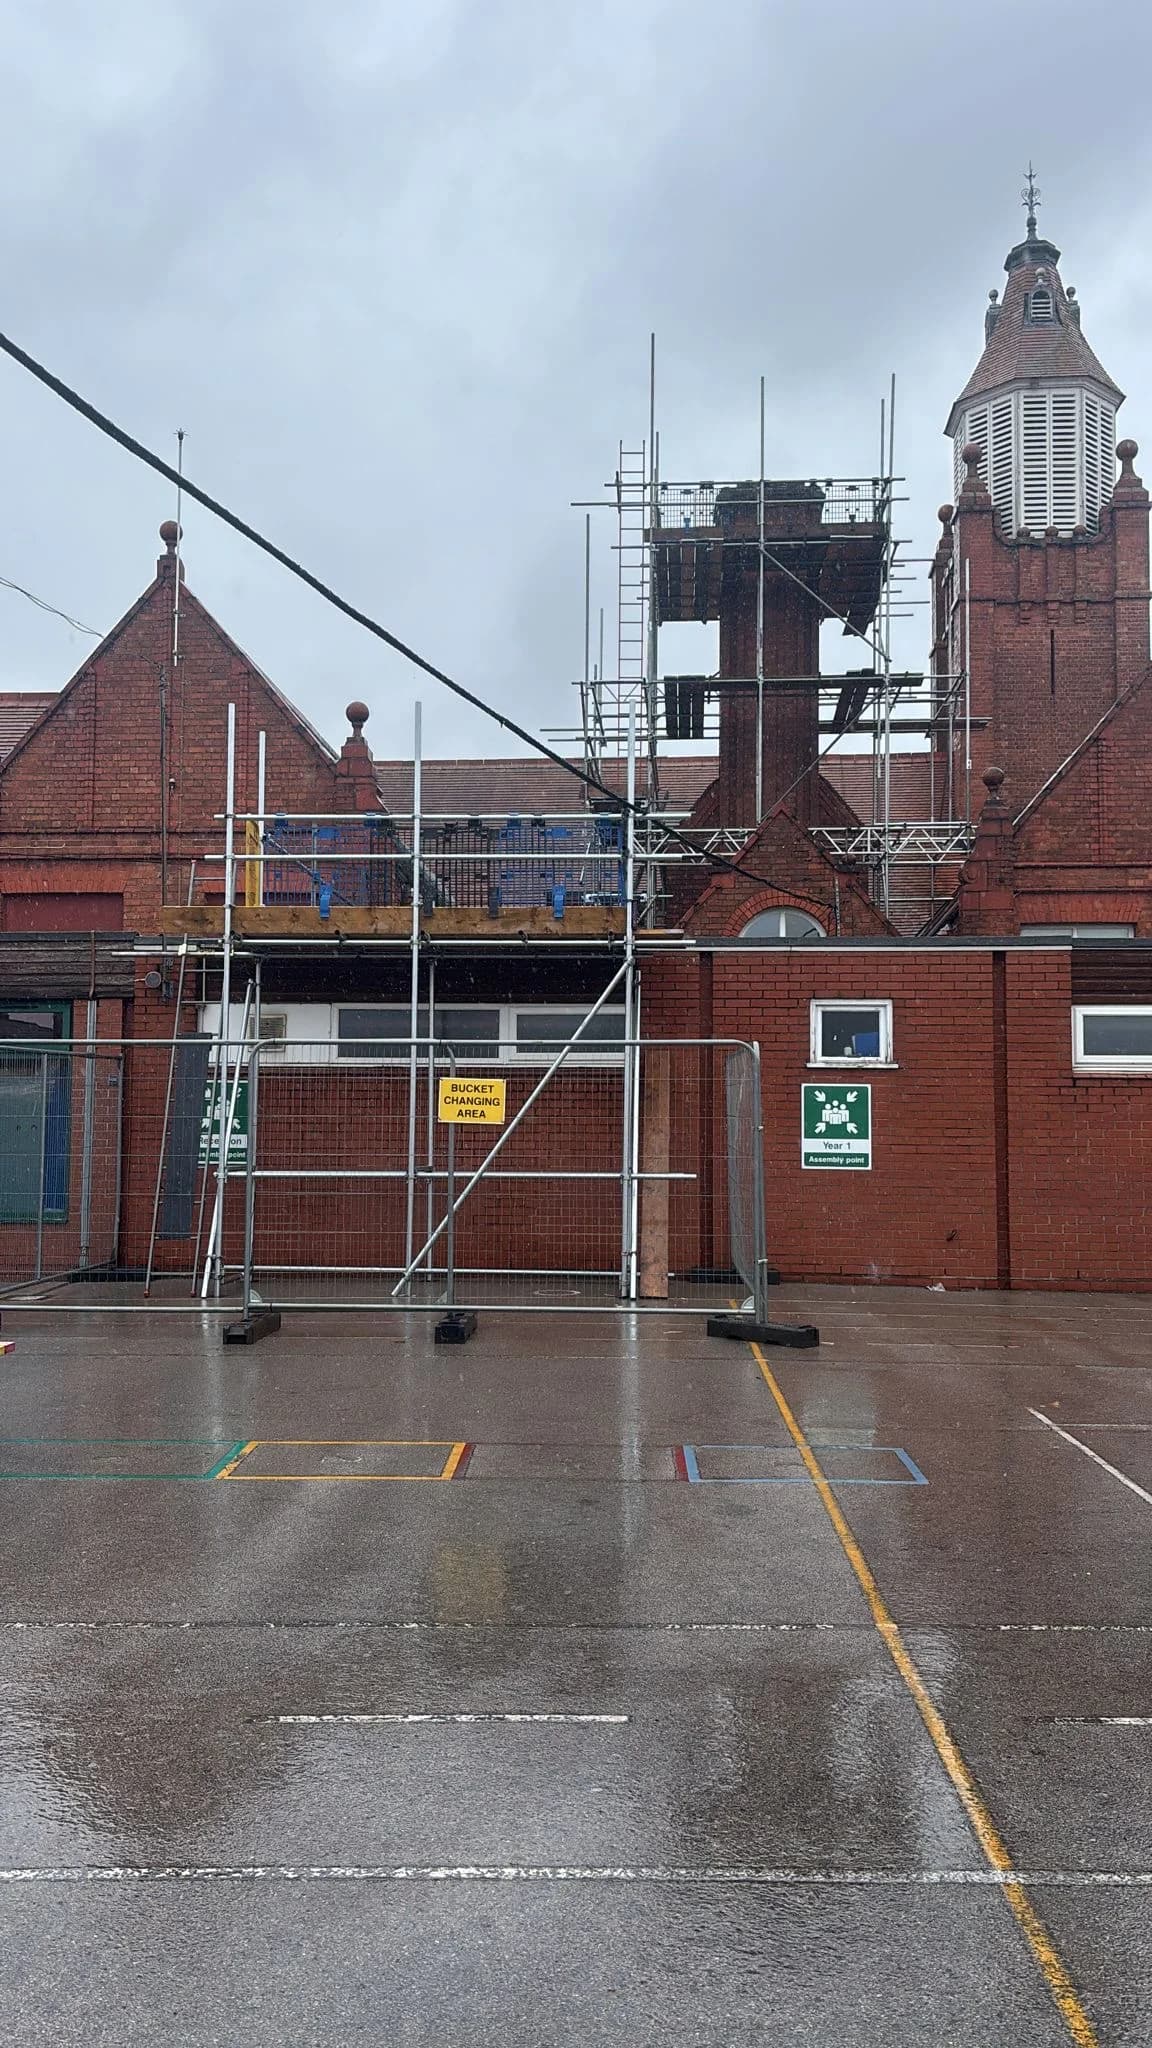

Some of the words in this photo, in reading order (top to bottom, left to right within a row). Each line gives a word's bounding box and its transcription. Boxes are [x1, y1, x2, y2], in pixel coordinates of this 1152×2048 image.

[451, 1084, 494, 1094] BUCKET
[444, 1096, 500, 1106] CHANGING
[457, 1109, 486, 1118] AREA
[823, 1141, 843, 1150] Year
[846, 1142, 851, 1150] 1
[809, 1156, 844, 1165] Assembly
[846, 1156, 865, 1164] point
